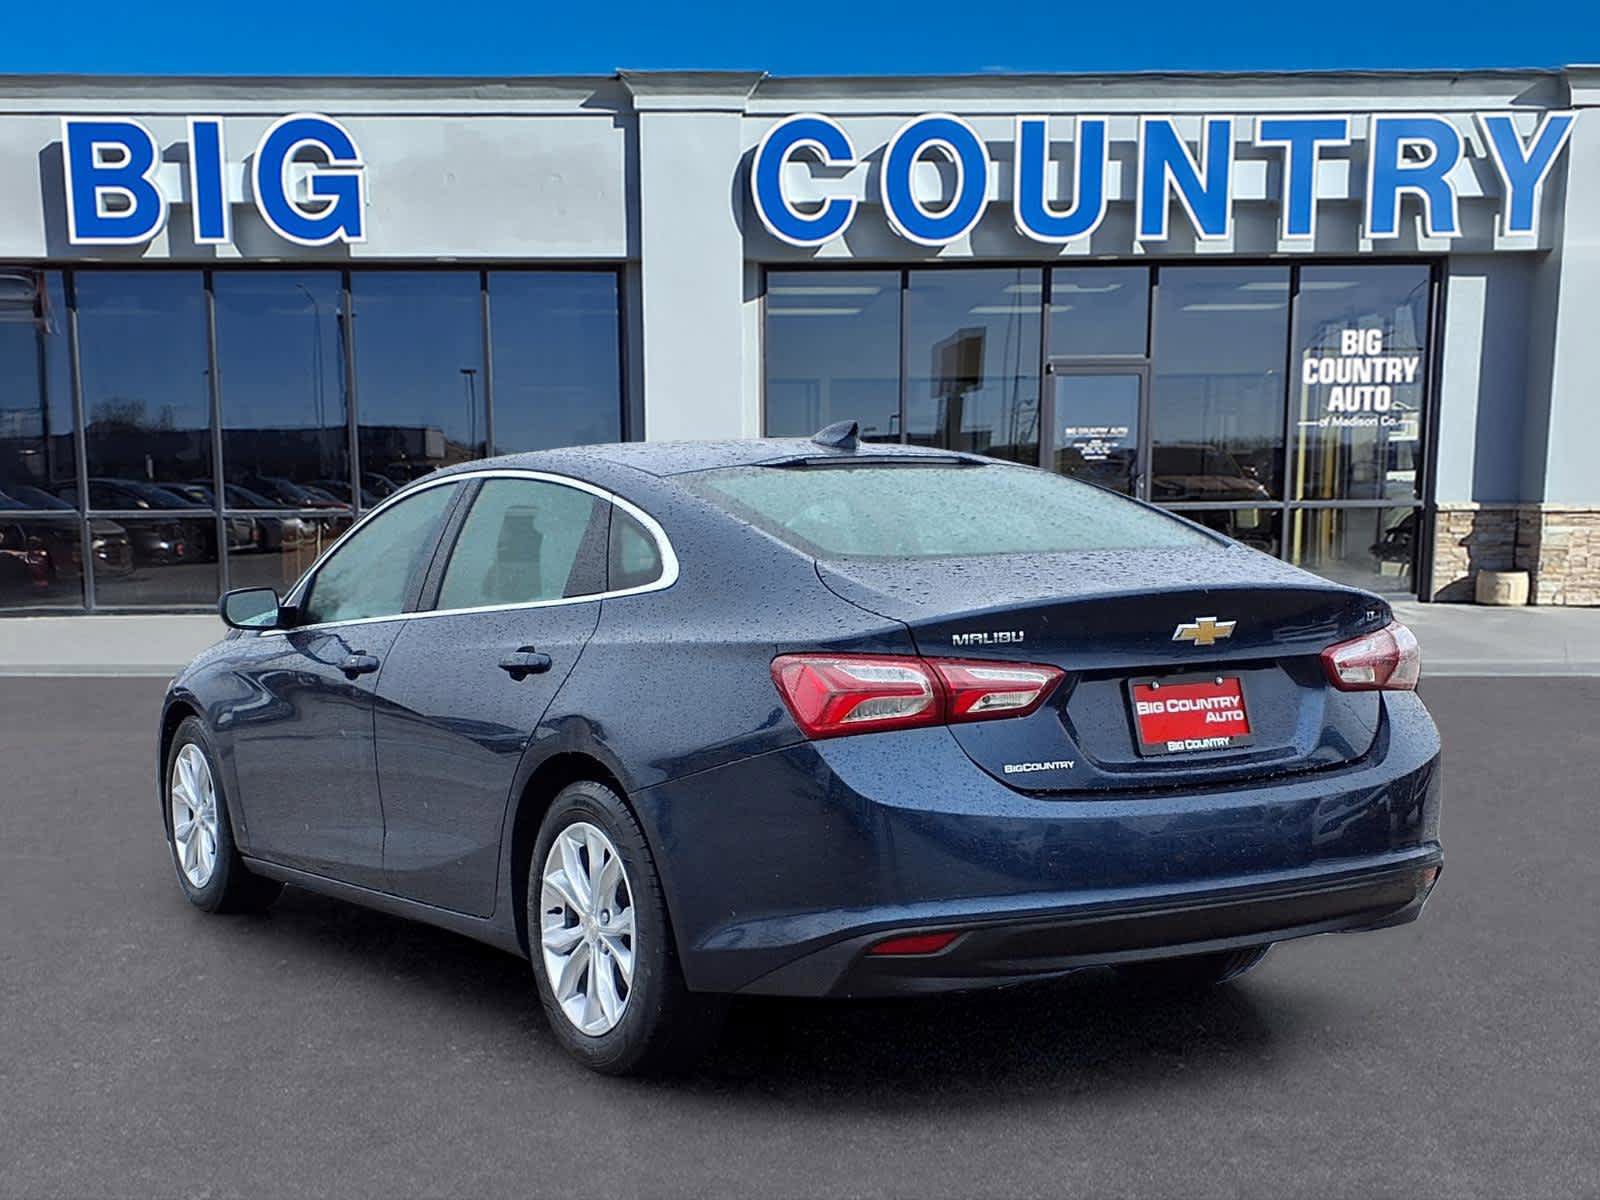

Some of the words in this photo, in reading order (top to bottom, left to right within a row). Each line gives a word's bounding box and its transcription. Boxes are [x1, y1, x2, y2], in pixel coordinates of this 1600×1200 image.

[61, 113, 367, 247] BIG
[751, 112, 1574, 248] COUNTRY
[1341, 329, 1382, 355] BIG
[1302, 357, 1419, 384] COUNTRY
[1327, 386, 1391, 412] AUTO
[952, 630, 1024, 646] MALIBU
[1205, 710, 1244, 723] AUTO
